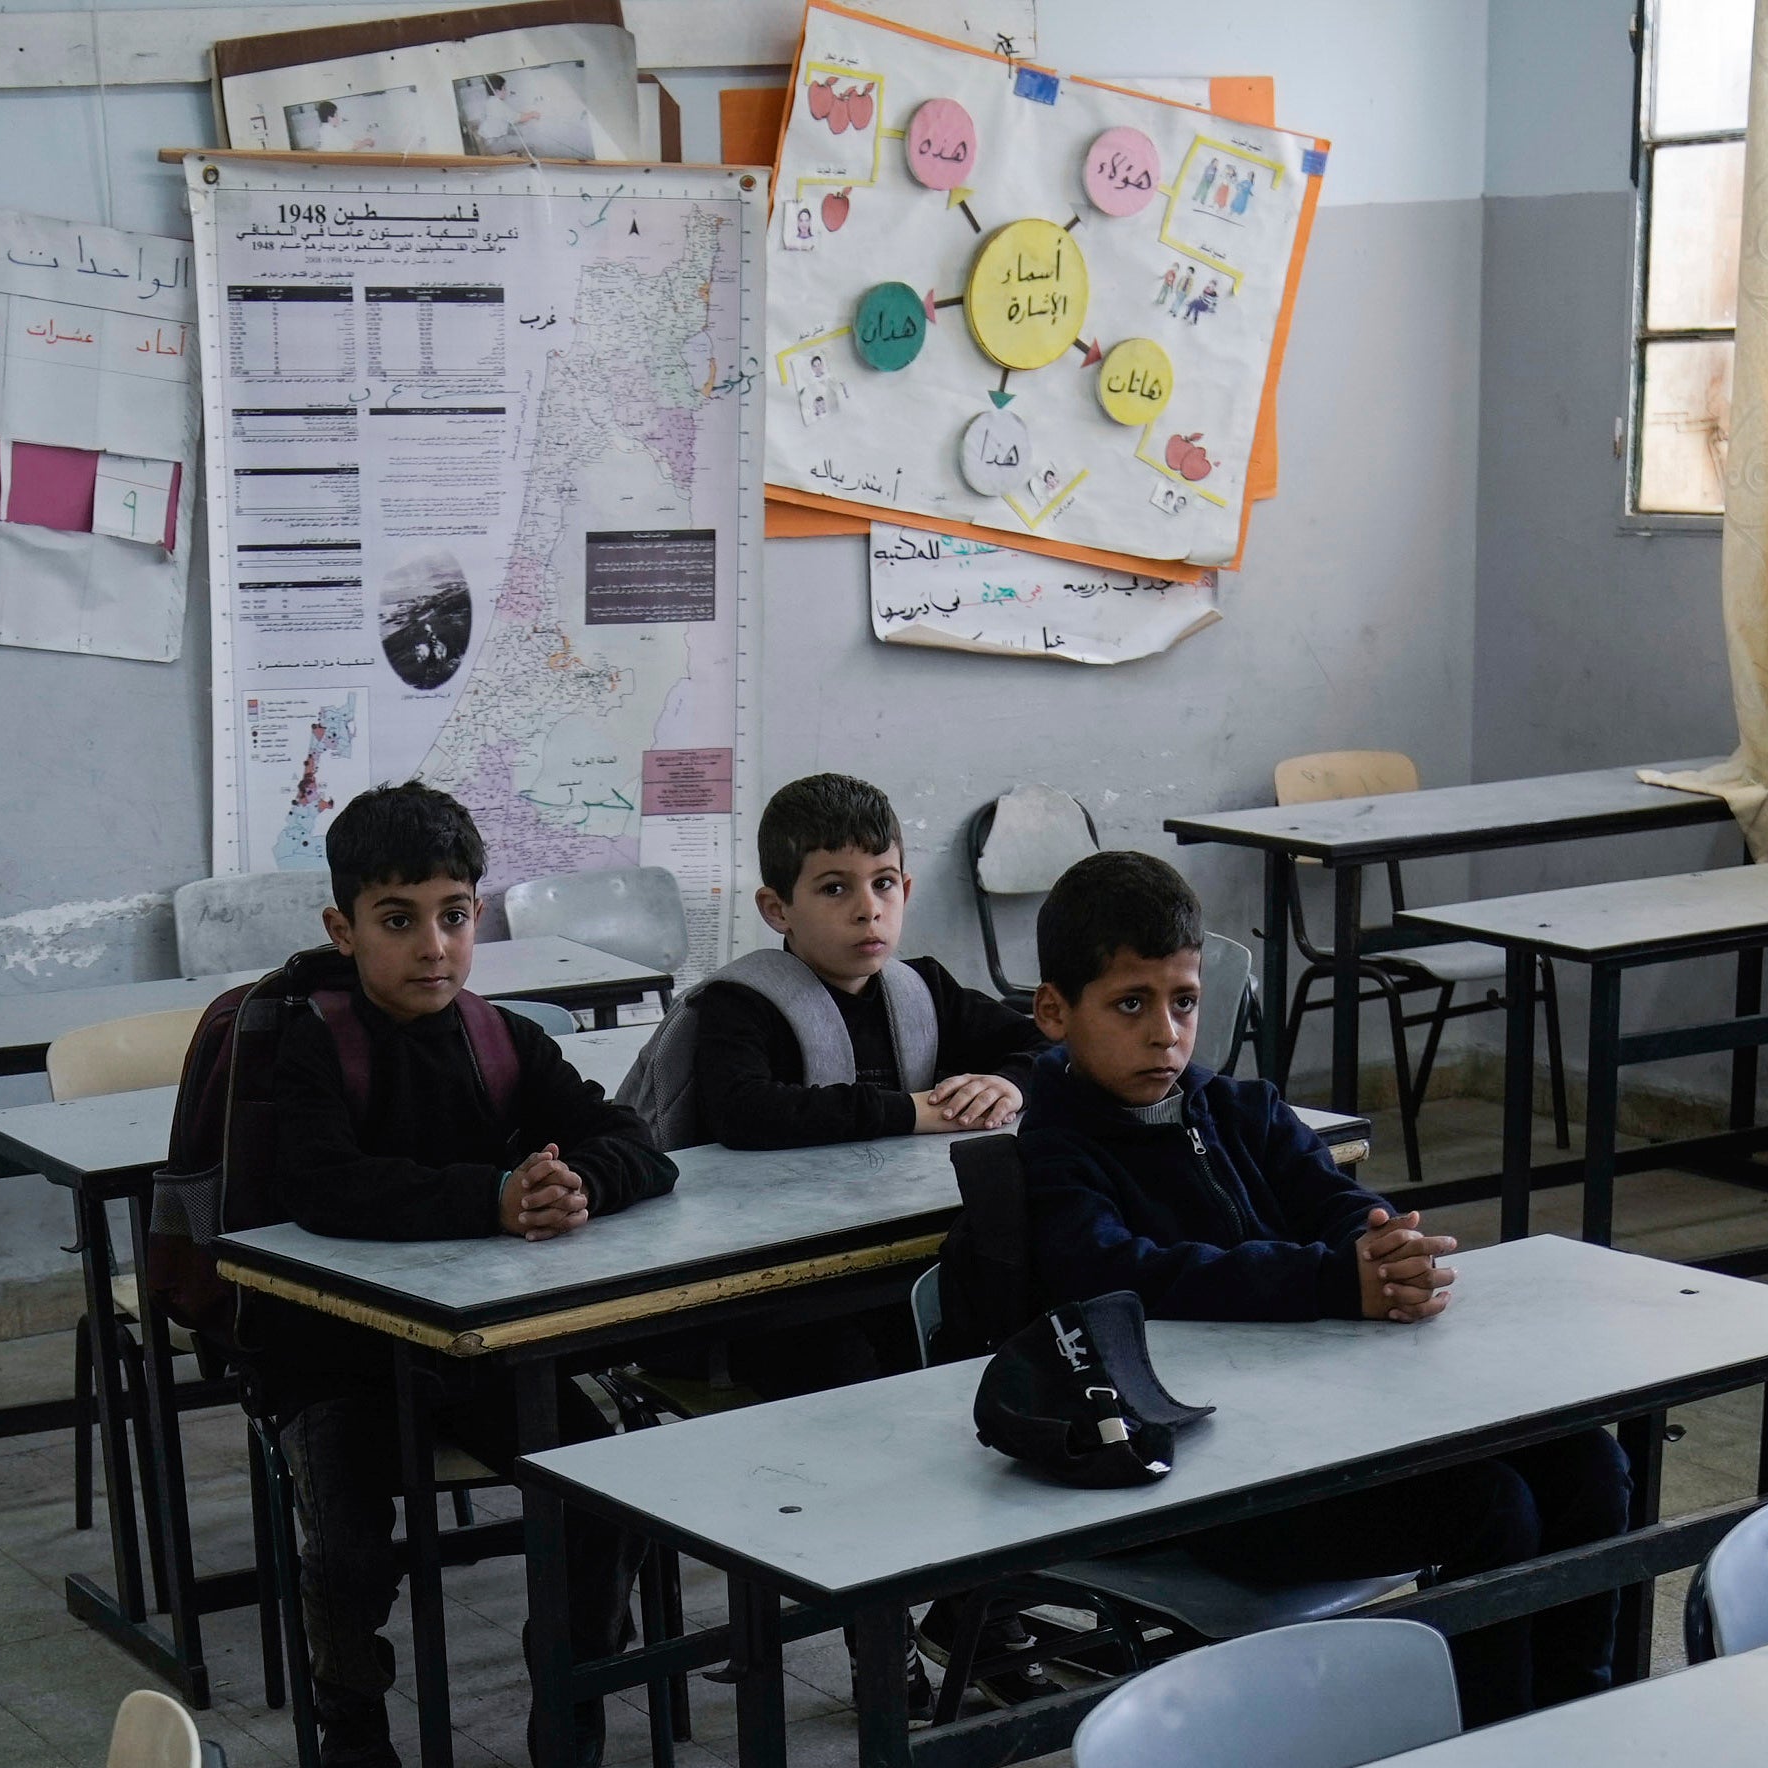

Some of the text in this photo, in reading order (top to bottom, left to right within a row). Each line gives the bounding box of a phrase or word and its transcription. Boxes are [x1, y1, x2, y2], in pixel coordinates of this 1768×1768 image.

[918, 138, 968, 162] هذه
[1097, 151, 1153, 190] هؤلاء
[276, 203, 328, 225] 1948
[251, 241, 276, 251] 1948
[518, 305, 557, 330] غرب
